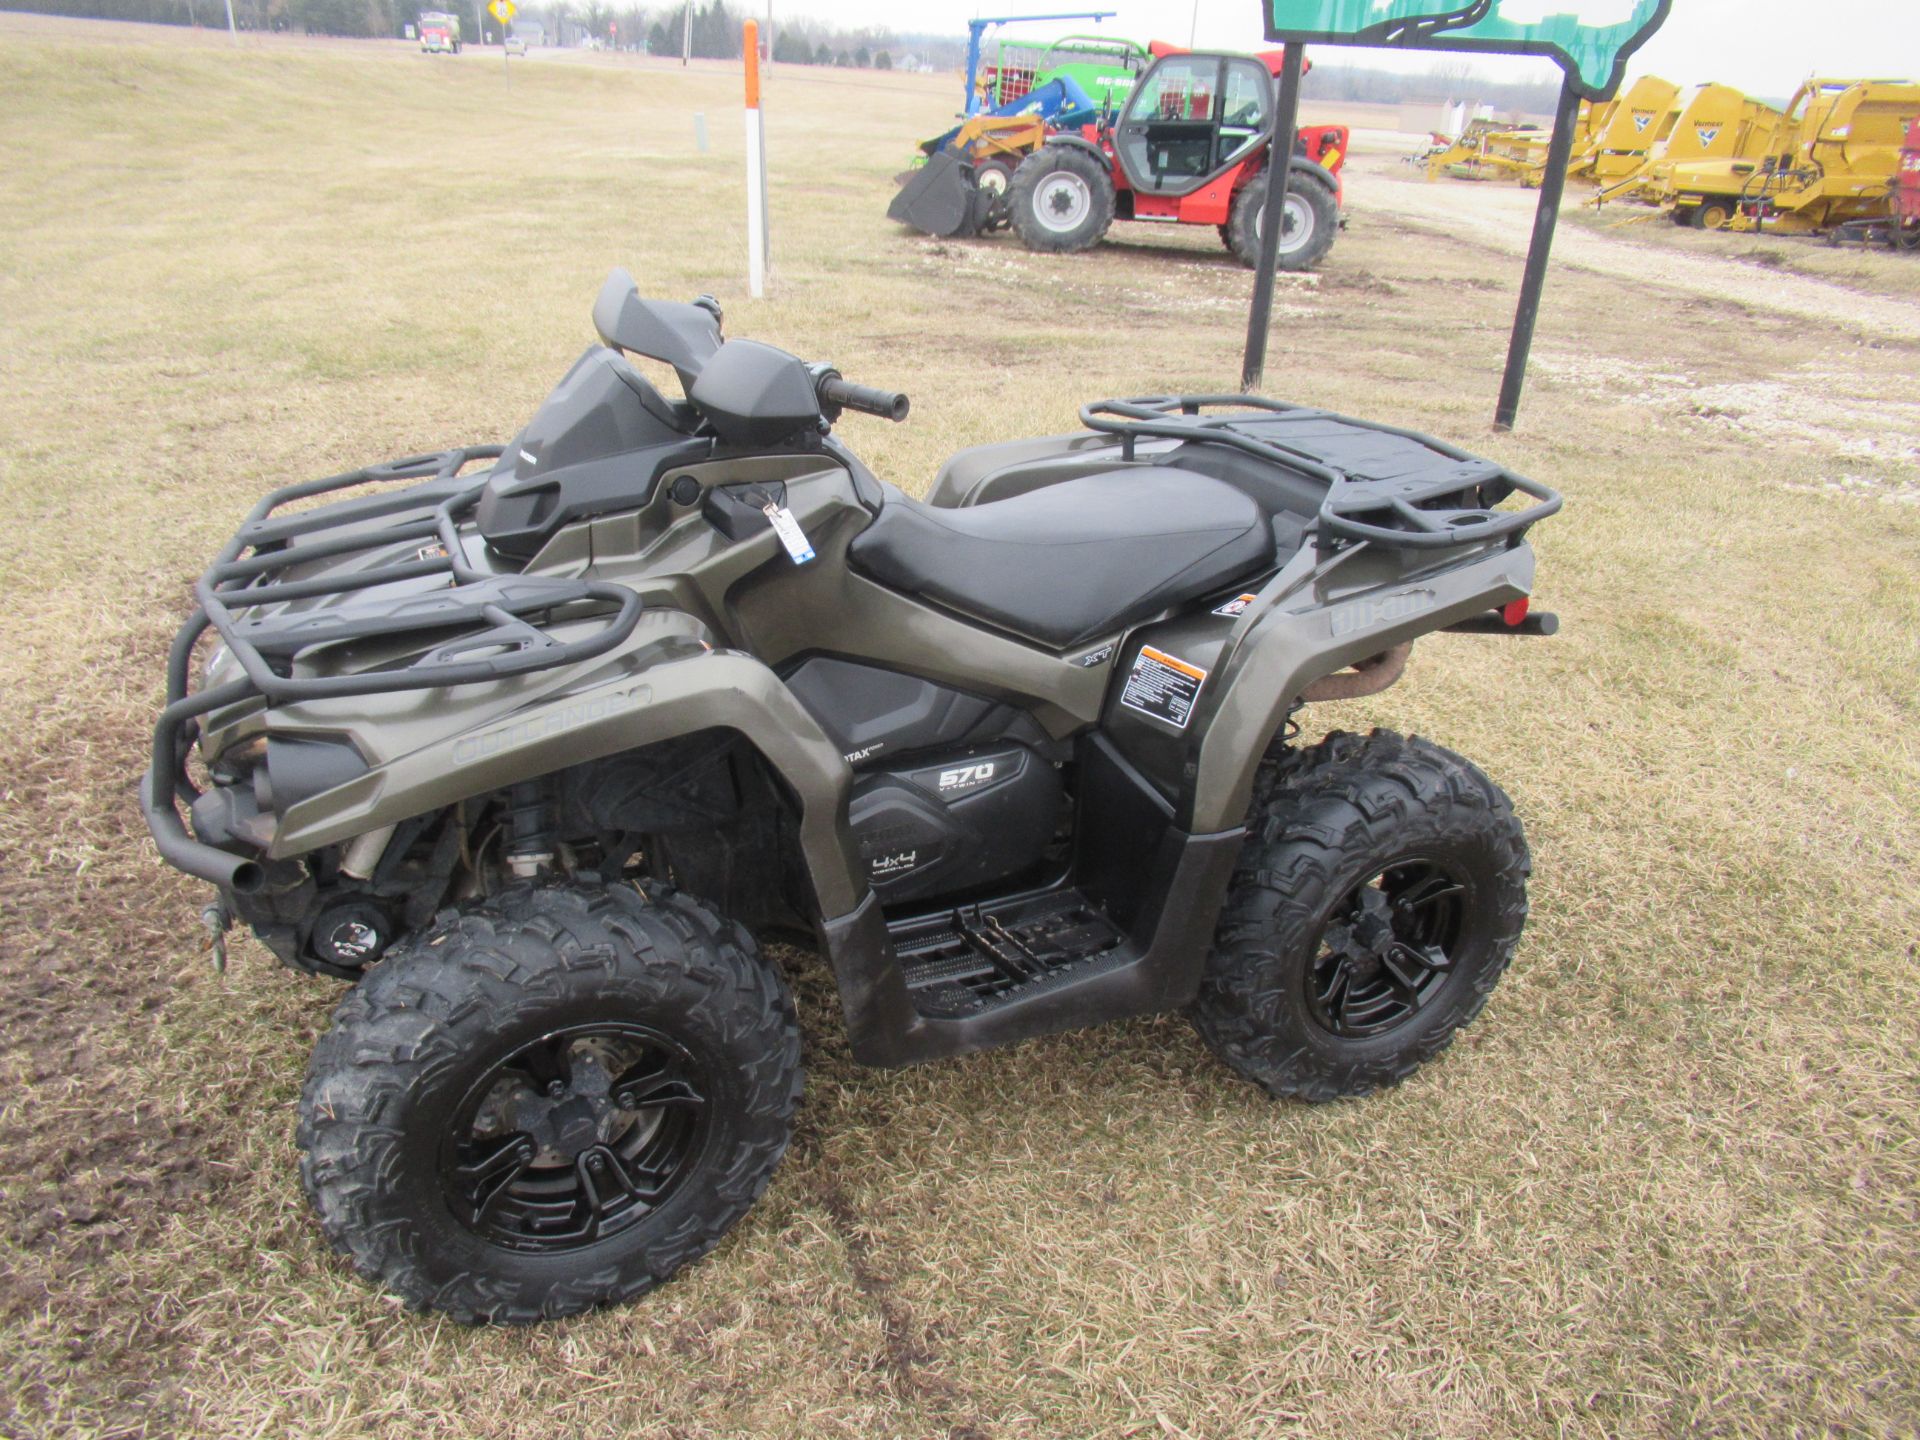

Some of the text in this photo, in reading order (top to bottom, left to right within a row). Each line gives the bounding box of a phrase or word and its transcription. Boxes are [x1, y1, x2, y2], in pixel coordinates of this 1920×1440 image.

[1084, 646, 1112, 666] XT
[843, 747, 870, 762] TAX
[939, 763, 994, 786] 570
